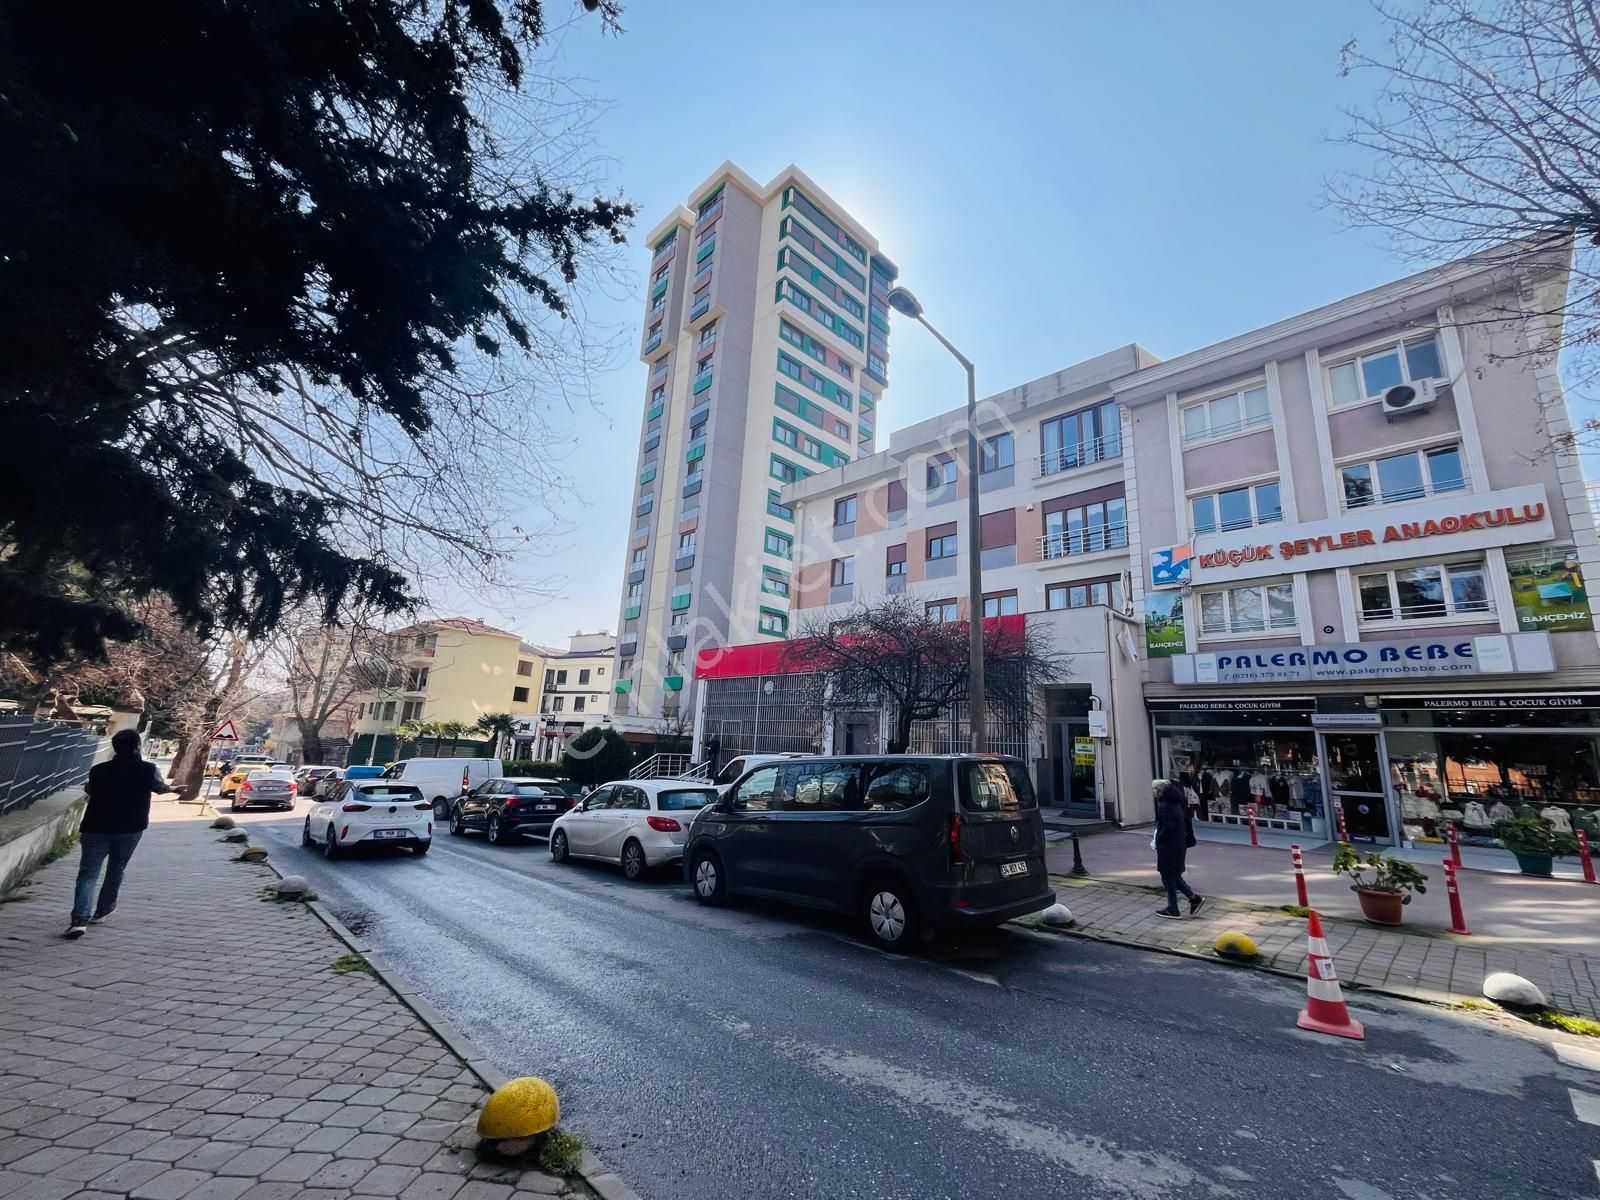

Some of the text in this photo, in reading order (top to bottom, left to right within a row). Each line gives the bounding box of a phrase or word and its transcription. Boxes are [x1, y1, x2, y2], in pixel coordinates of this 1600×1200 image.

[1199, 502, 1546, 568] KÜÇÜK ŞEYLER ANAOKULU
[1218, 648, 1368, 669] PALERMO
[1379, 642, 1473, 662] BEBE
[1423, 700, 1469, 708] PALERMO
[1509, 699, 1546, 708] ÇOCUK
[1549, 698, 1583, 706] GİYİM
